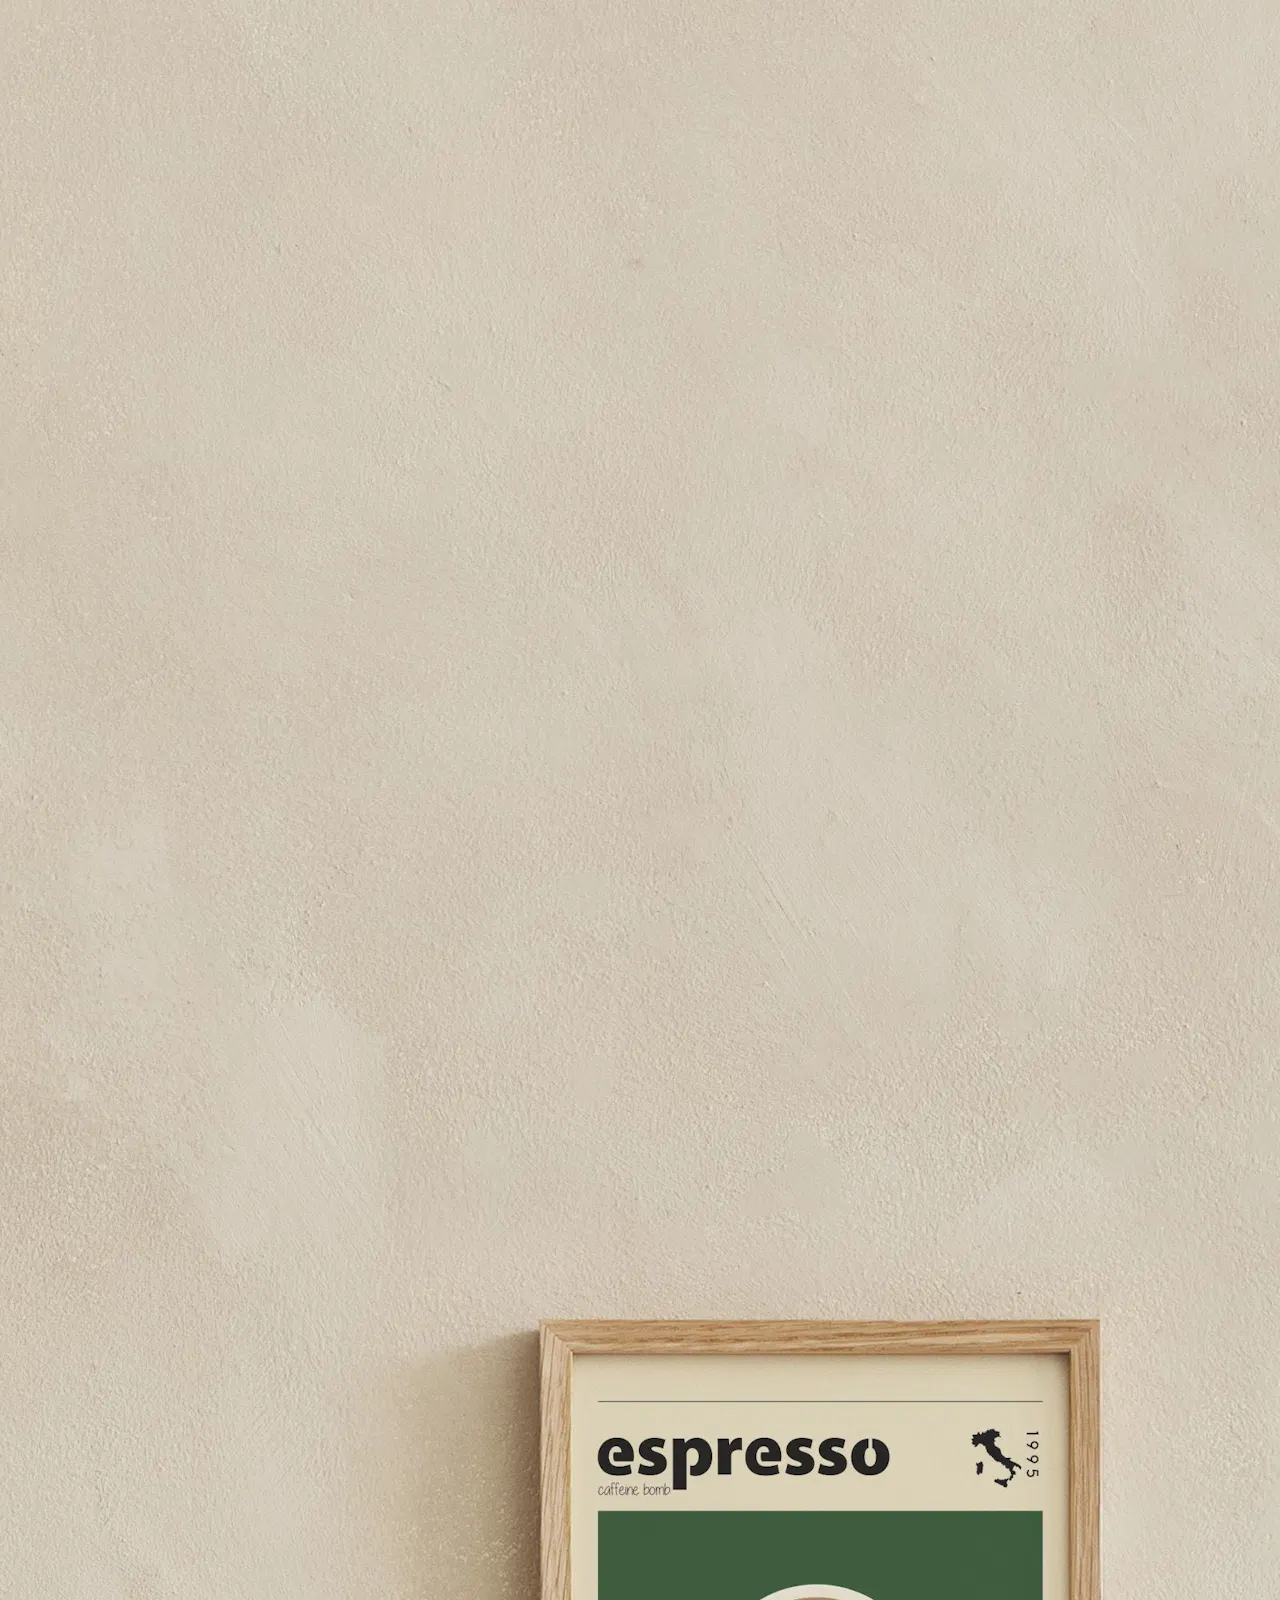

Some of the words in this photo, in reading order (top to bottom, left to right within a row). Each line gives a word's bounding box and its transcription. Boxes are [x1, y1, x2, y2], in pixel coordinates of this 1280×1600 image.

[597, 1437, 890, 1490] espresso
[1026, 1431, 1039, 1477] 1995
[597, 1482, 639, 1496] caffeine
[643, 1483, 671, 1496] bomb
